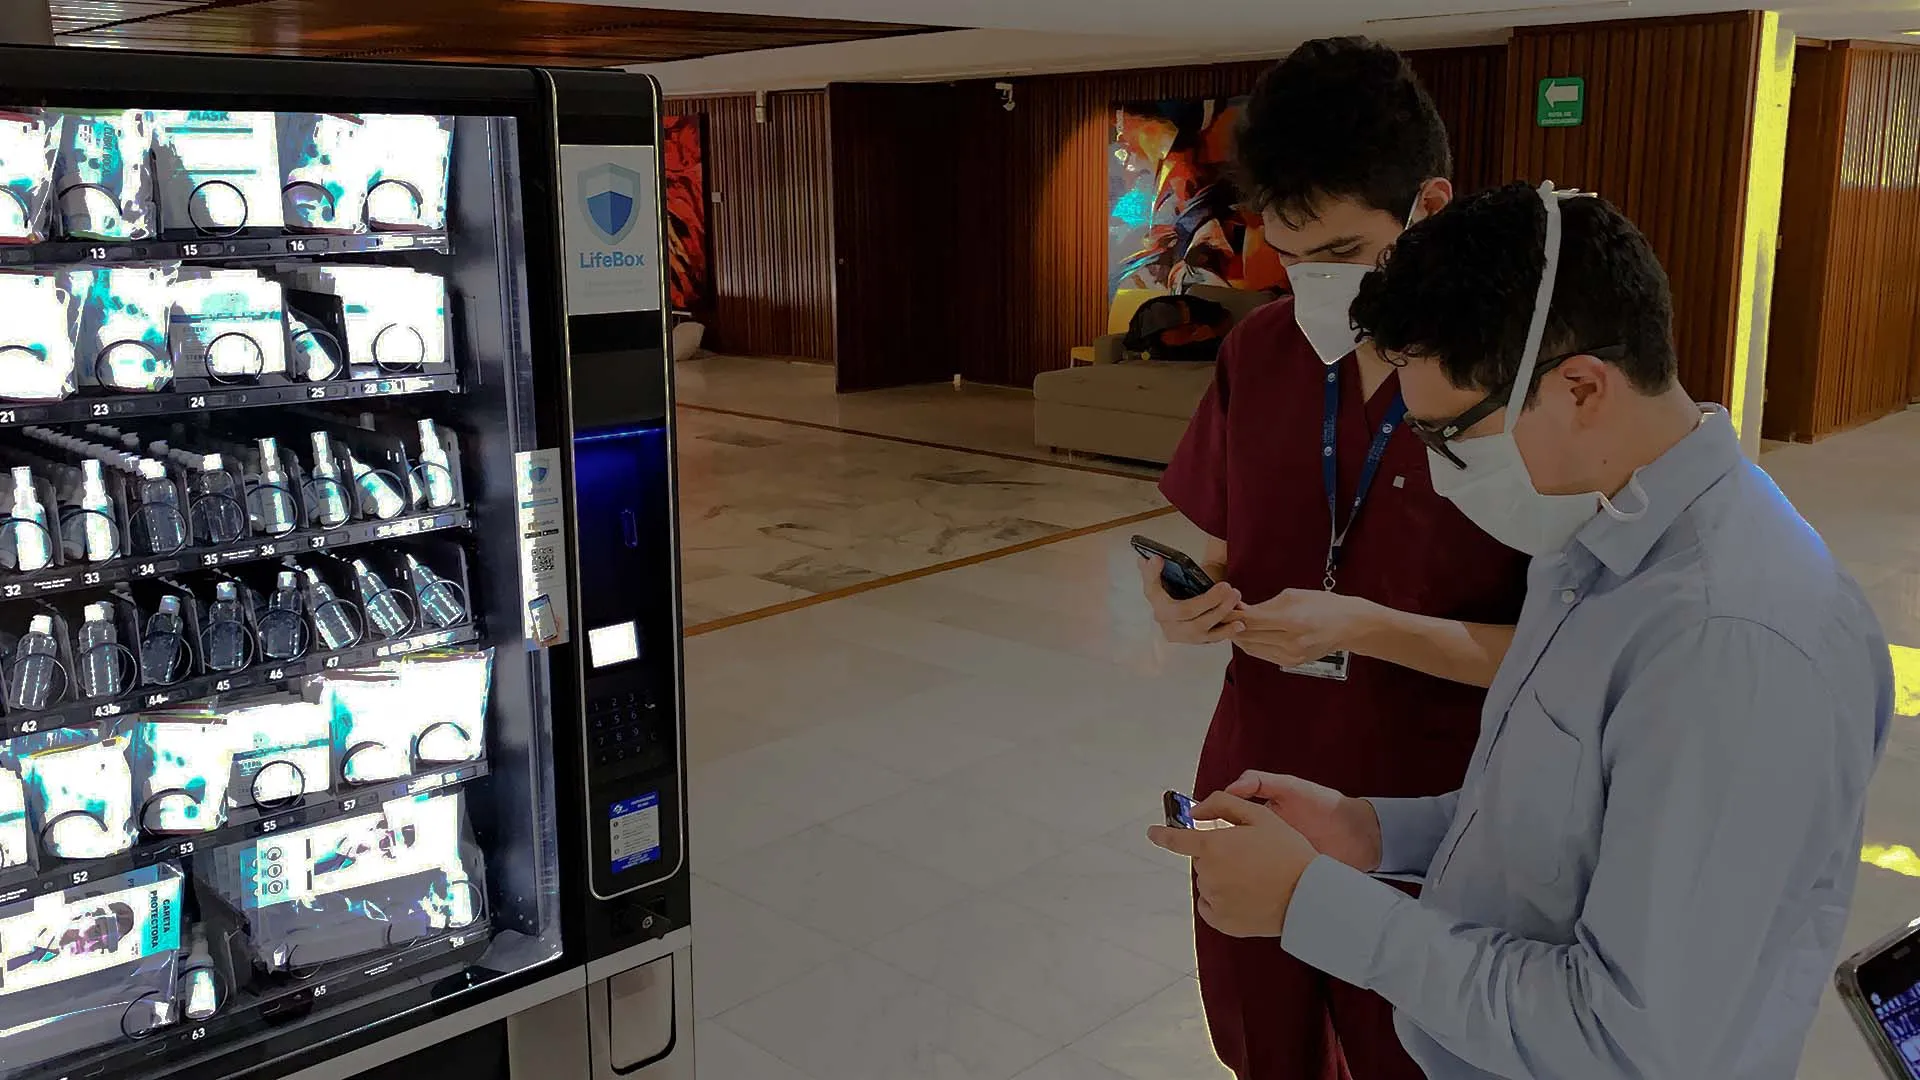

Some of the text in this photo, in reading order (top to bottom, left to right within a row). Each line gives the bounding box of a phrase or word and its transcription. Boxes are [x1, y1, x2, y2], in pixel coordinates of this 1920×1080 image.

[184, 245, 197, 255] 15
[291, 241, 304, 251] 16
[91, 248, 106, 259] 13
[580, 251, 645, 269] LifeBox
[311, 387, 325, 398] 25
[191, 397, 205, 407] 24
[94, 404, 108, 415] 23
[0, 411, 15, 423] 21
[312, 536, 325, 547] 37
[261, 545, 274, 556] 36
[204, 554, 218, 565] 35
[140, 564, 155, 575] 34
[85, 572, 100, 584] 33
[4, 584, 21, 596] 32
[217, 680, 230, 690] 45
[21, 720, 37, 732] 42
[344, 799, 355, 810] 57
[264, 820, 276, 831] 55
[181, 842, 193, 856] 53
[73, 871, 89, 885] 52
[150, 889, 159, 949] PROTECTORA
[162, 899, 170, 933] CARETA
[313, 984, 326, 996] 65
[192, 1028, 205, 1039] 63
